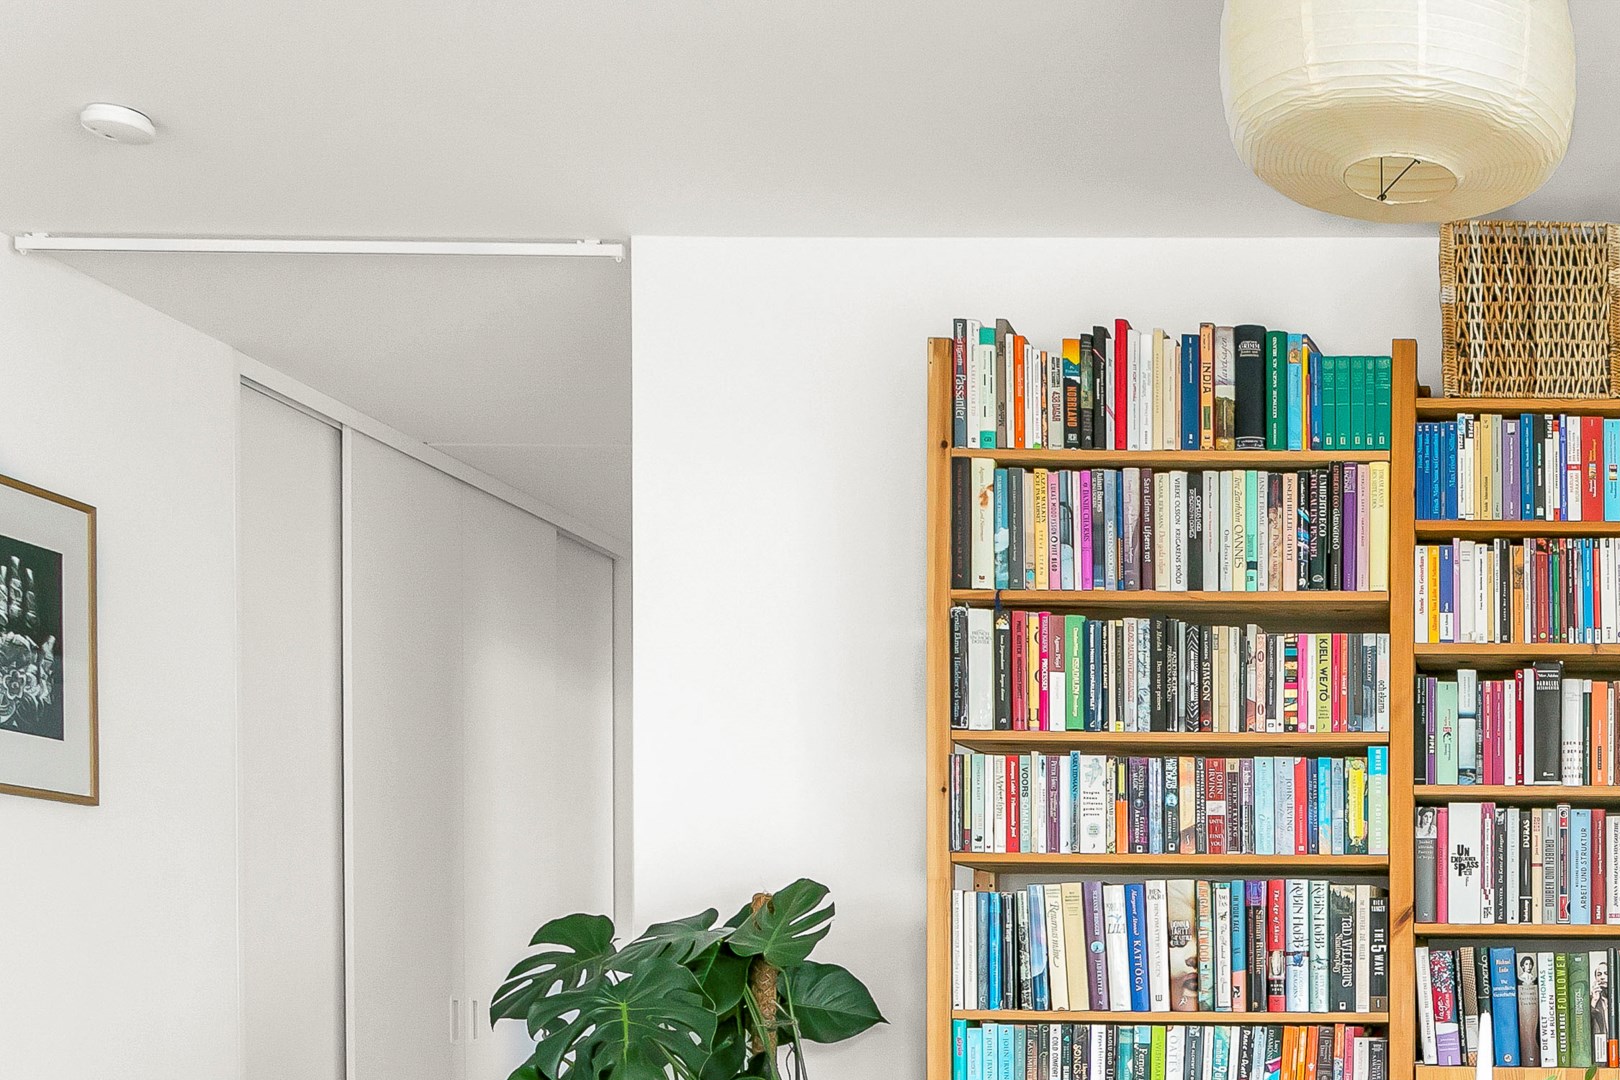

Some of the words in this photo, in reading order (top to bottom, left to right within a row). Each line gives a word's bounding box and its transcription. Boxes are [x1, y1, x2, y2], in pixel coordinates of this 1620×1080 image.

[1202, 362, 1212, 394] INDIA
[955, 374, 966, 420] Passanter
[1052, 391, 1061, 402] 438
[1067, 386, 1077, 427] NORRLAND
[1052, 404, 1061, 422] DAGAR
[1143, 526, 1151, 550] Lifsens
[1234, 525, 1243, 568] OANNES
[1175, 565, 1183, 584] SKÖLD
[1319, 639, 1328, 663] KJELL
[1202, 662, 1210, 701] SIMSON
[1378, 680, 1386, 691] och
[1378, 691, 1386, 713] ekarna
[1255, 909, 1263, 938] Salman
[1374, 928, 1384, 942] THE
[1255, 942, 1263, 974] Rushdie
[1374, 955, 1384, 976] WAVE
[1557, 956, 1566, 1009] FOLLOWER
[1550, 1030, 1555, 1038] IM
[1138, 1048, 1147, 1076] Ferney
